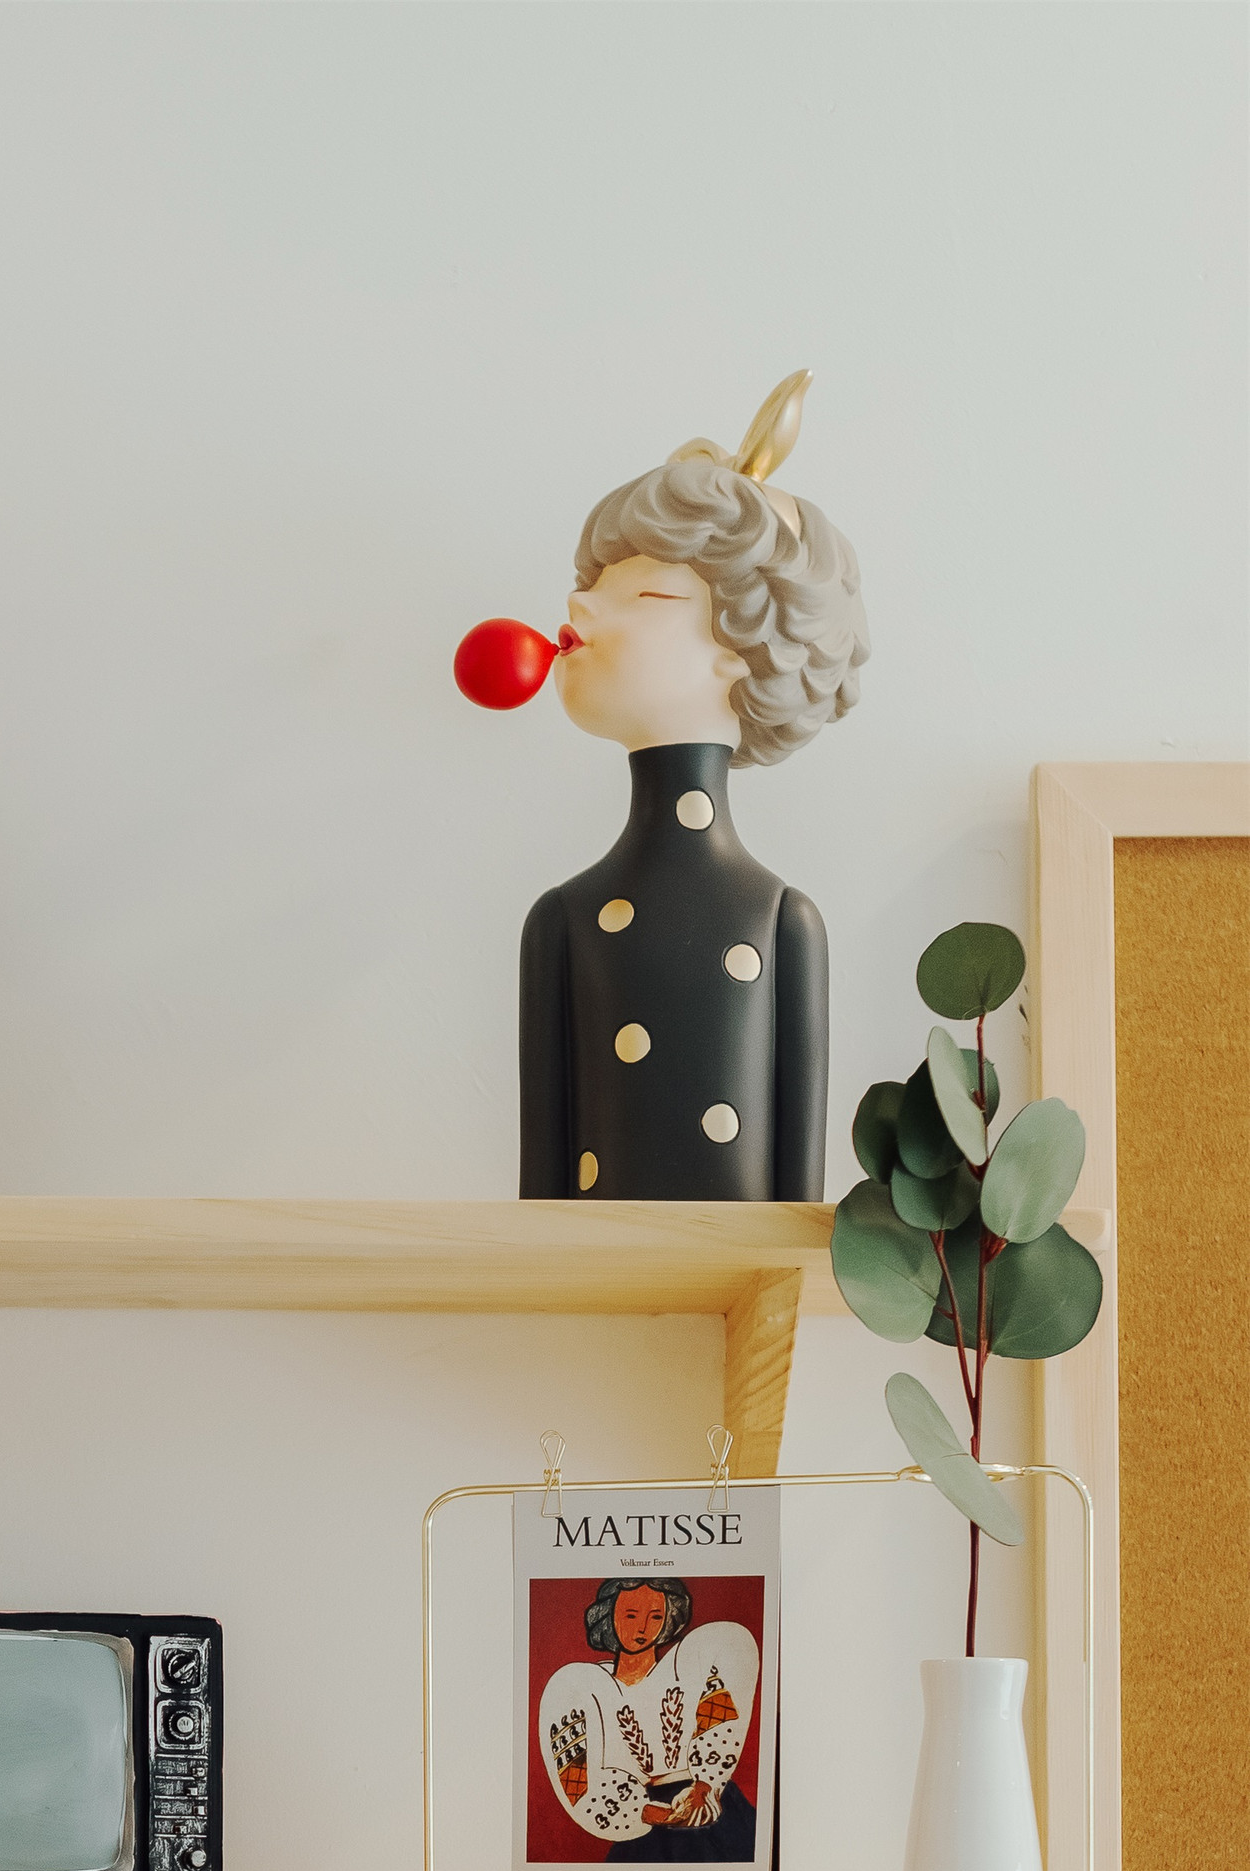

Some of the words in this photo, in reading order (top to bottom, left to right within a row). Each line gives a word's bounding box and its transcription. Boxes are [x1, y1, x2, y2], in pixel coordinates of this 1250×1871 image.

[552, 1513, 743, 1548] MATISSE
[620, 1558, 651, 1567] Volkmar
[653, 1558, 675, 1567] Essers
